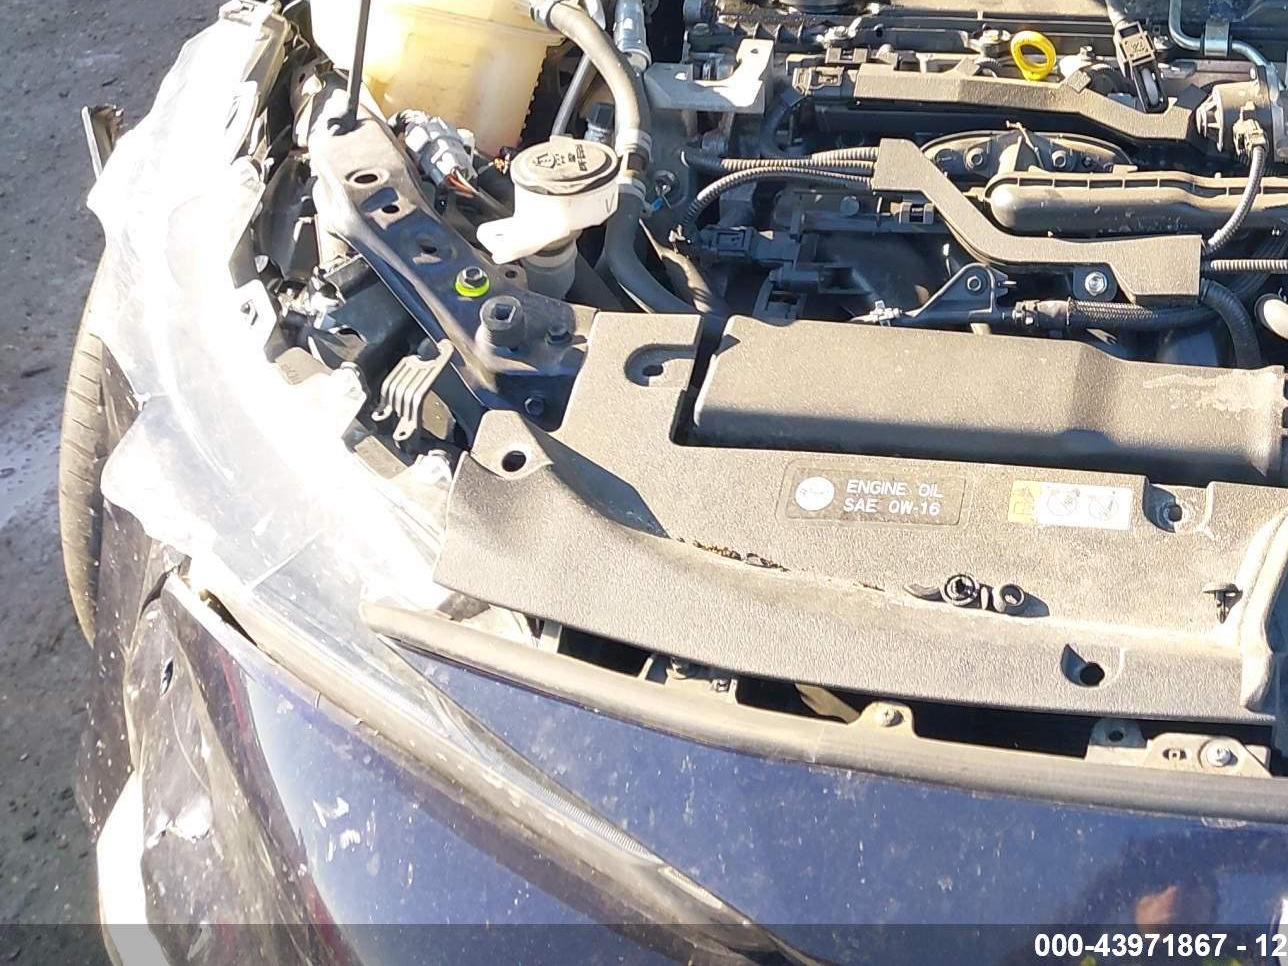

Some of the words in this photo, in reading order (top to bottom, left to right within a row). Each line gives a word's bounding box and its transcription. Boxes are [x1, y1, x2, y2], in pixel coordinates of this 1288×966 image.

[846, 479, 908, 496] ENGINE
[918, 483, 944, 498] OIL
[843, 497, 878, 513] SAE
